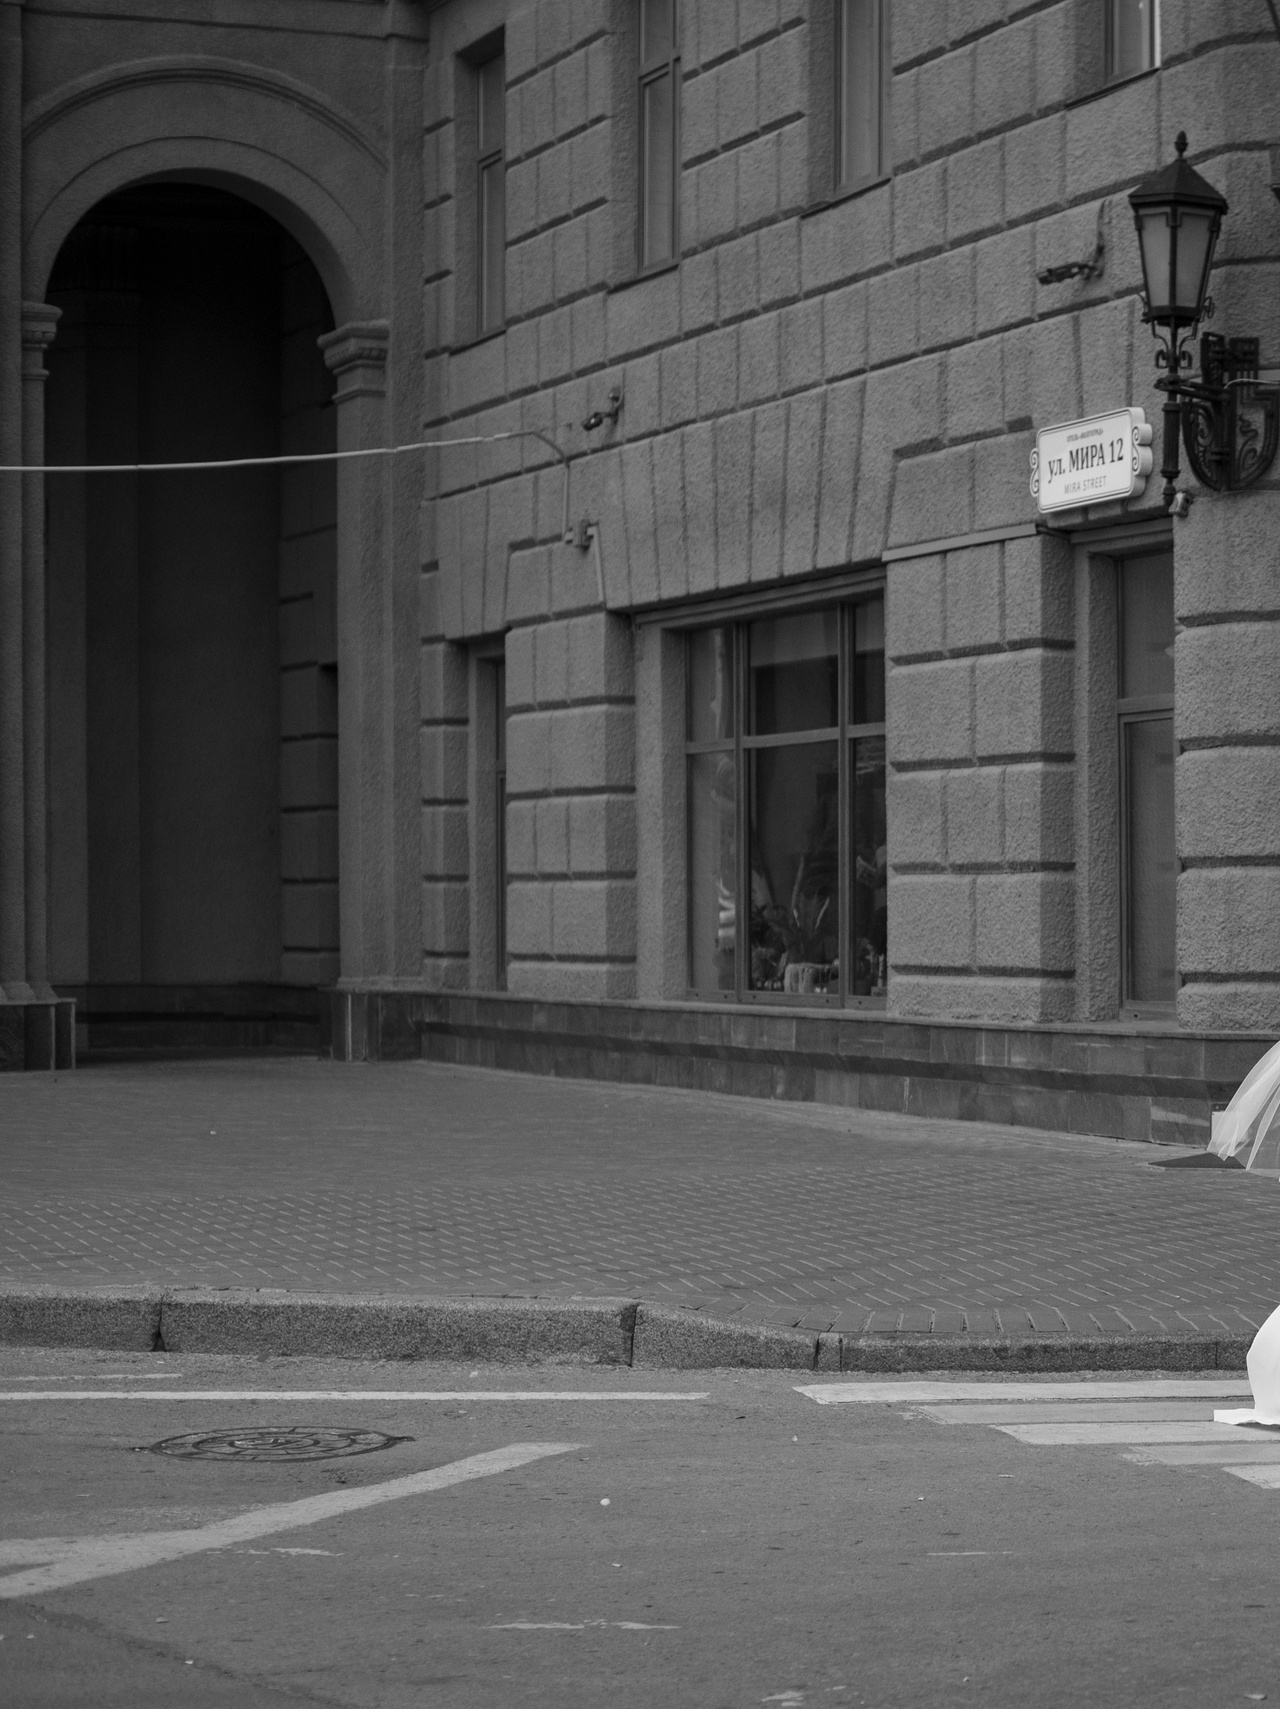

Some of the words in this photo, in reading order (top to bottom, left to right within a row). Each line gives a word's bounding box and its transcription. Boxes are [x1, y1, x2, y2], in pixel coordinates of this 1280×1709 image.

[1048, 458, 1066, 484] ул.
[1069, 443, 1106, 473] МИРА
[1109, 438, 1124, 464] 12
[1064, 482, 1081, 494] MIRA
[1083, 475, 1107, 491] STREET
